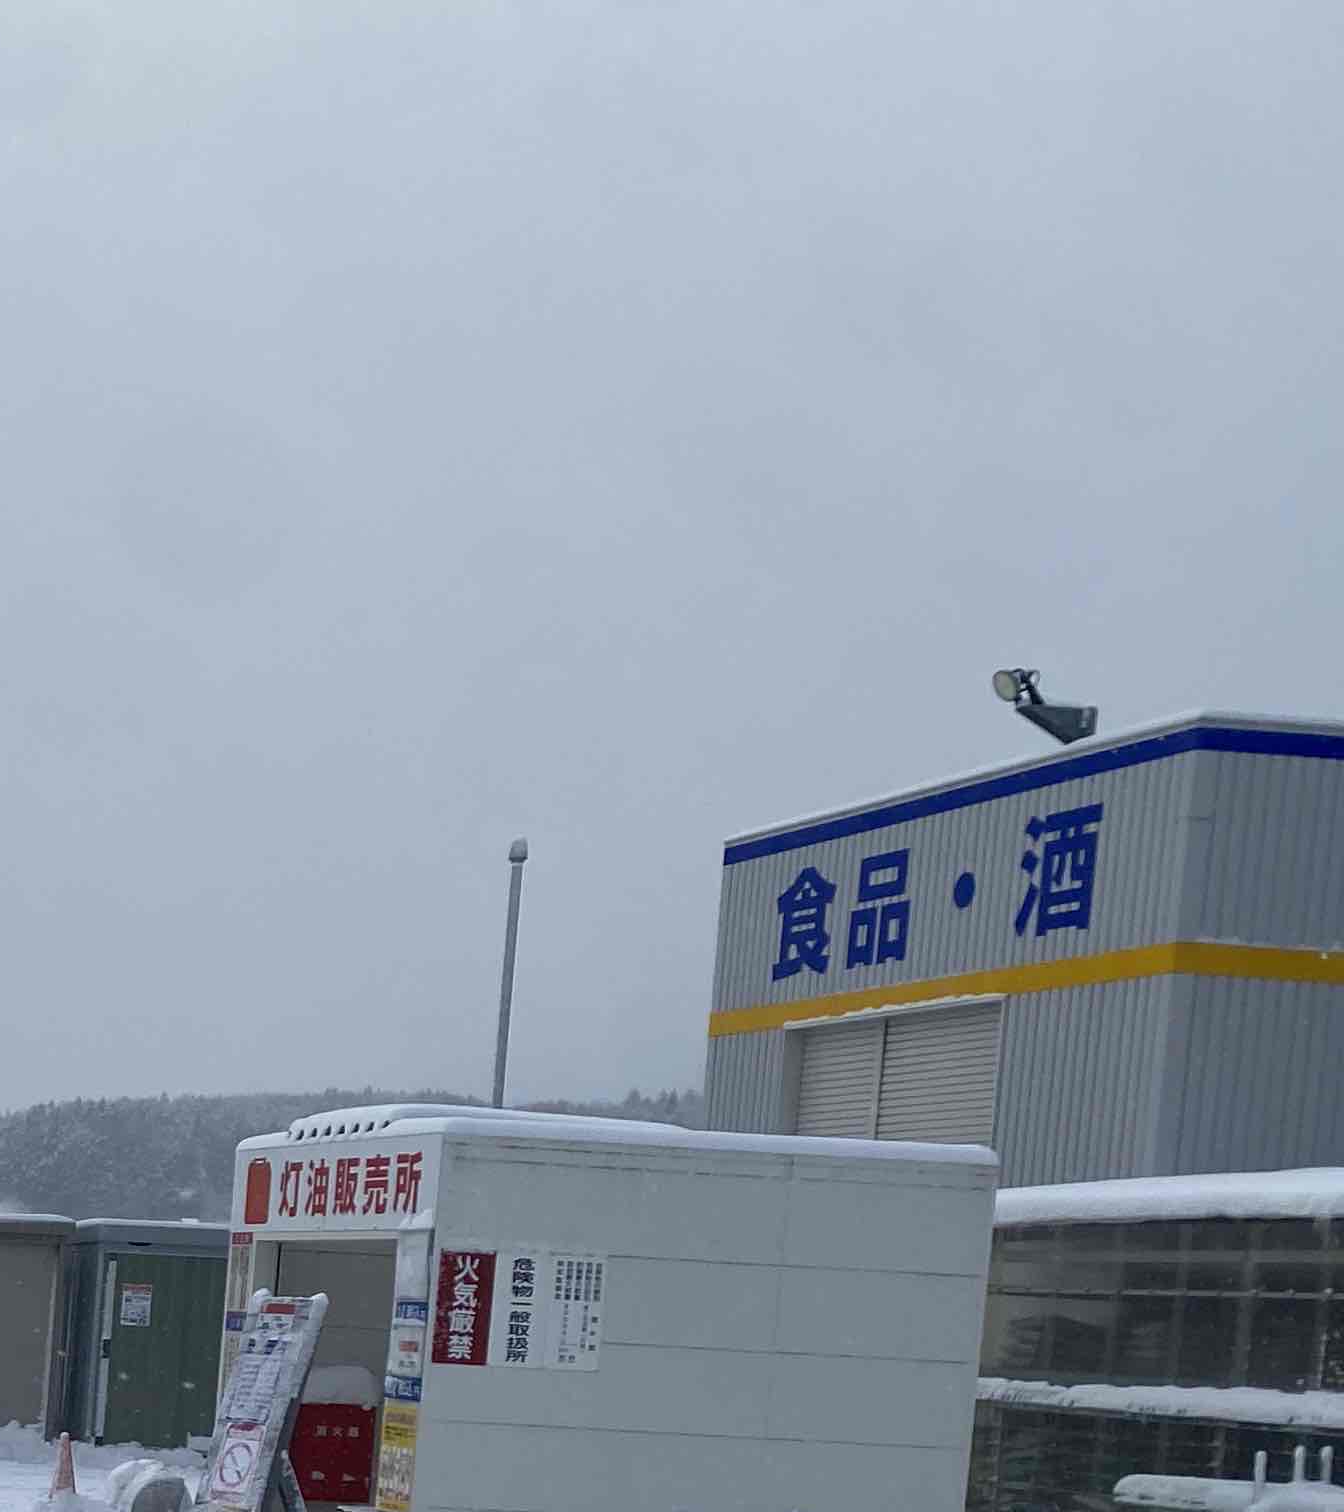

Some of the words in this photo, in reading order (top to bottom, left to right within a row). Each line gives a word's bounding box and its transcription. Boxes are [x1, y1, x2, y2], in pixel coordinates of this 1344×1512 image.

[771, 803, 1105, 981] 食品・酒
[277, 1150, 424, 1218] 灯油販売所
[446, 1255, 481, 1361] 火気厳禁
[504, 1257, 536, 1363] 危険物一般取扱所
